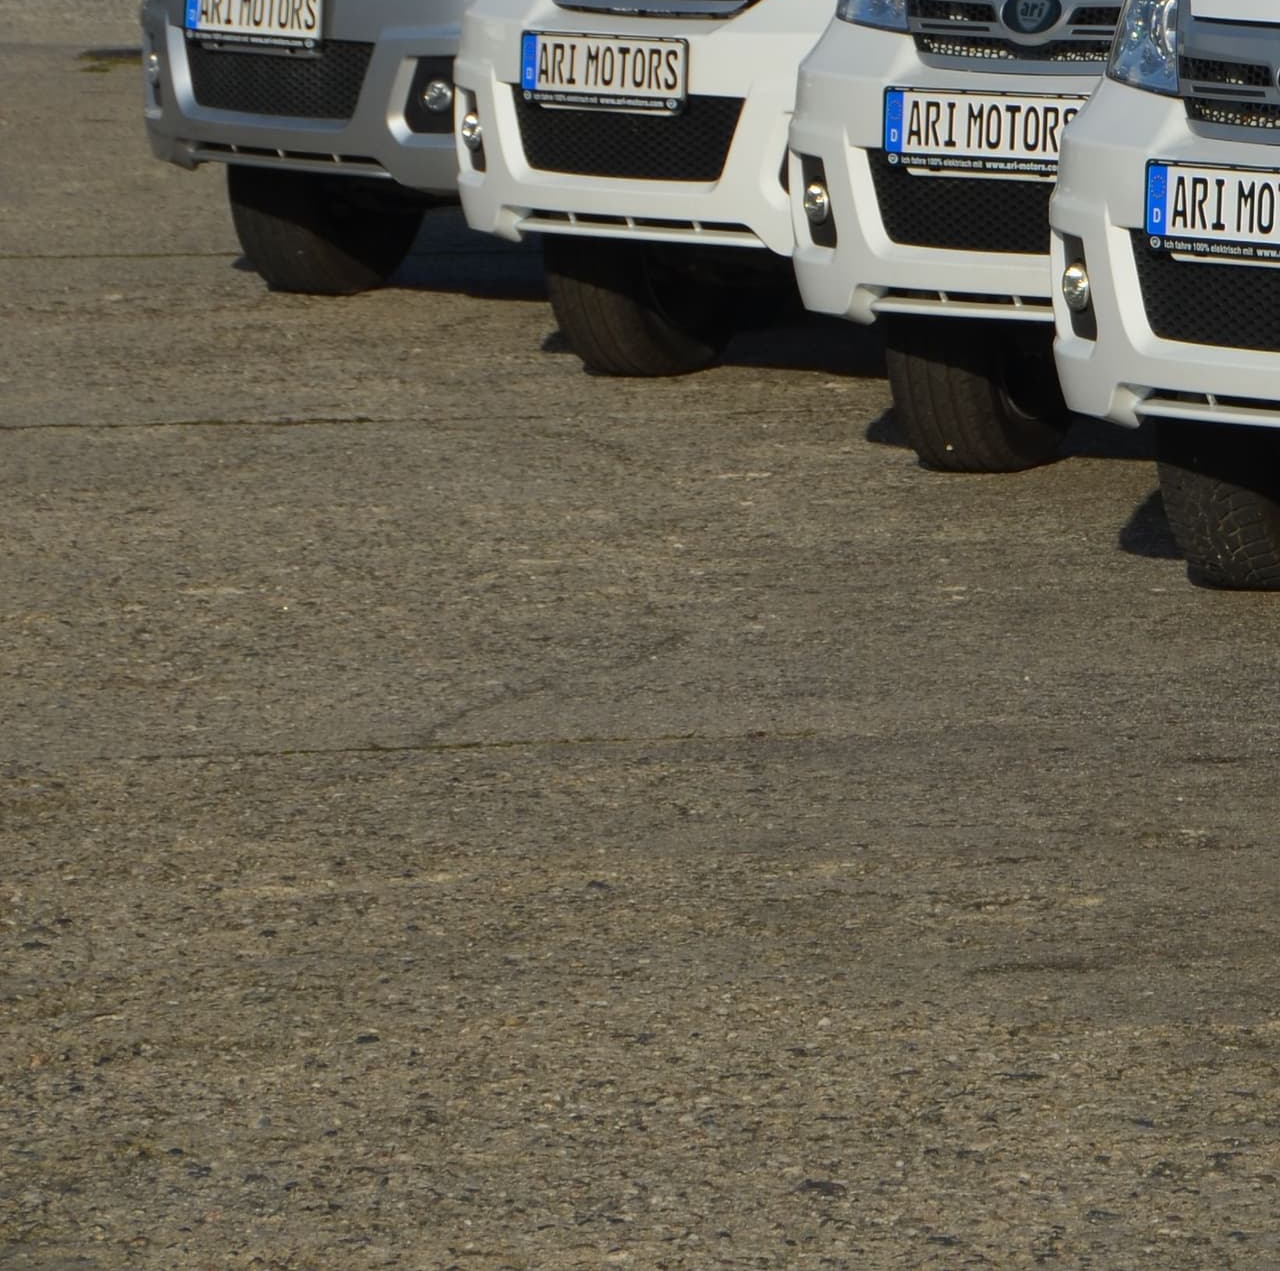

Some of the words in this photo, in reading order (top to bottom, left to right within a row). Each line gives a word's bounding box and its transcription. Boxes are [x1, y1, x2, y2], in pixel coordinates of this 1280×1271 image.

[537, 43, 577, 86] ARI
[584, 45, 679, 91] MOTORS
[906, 100, 956, 148] ARI
[1152, 208, 1161, 224] D
[1171, 176, 1226, 232] ARI
[1164, 239, 1174, 249] Ich
[1193, 242, 1210, 252] 100%
